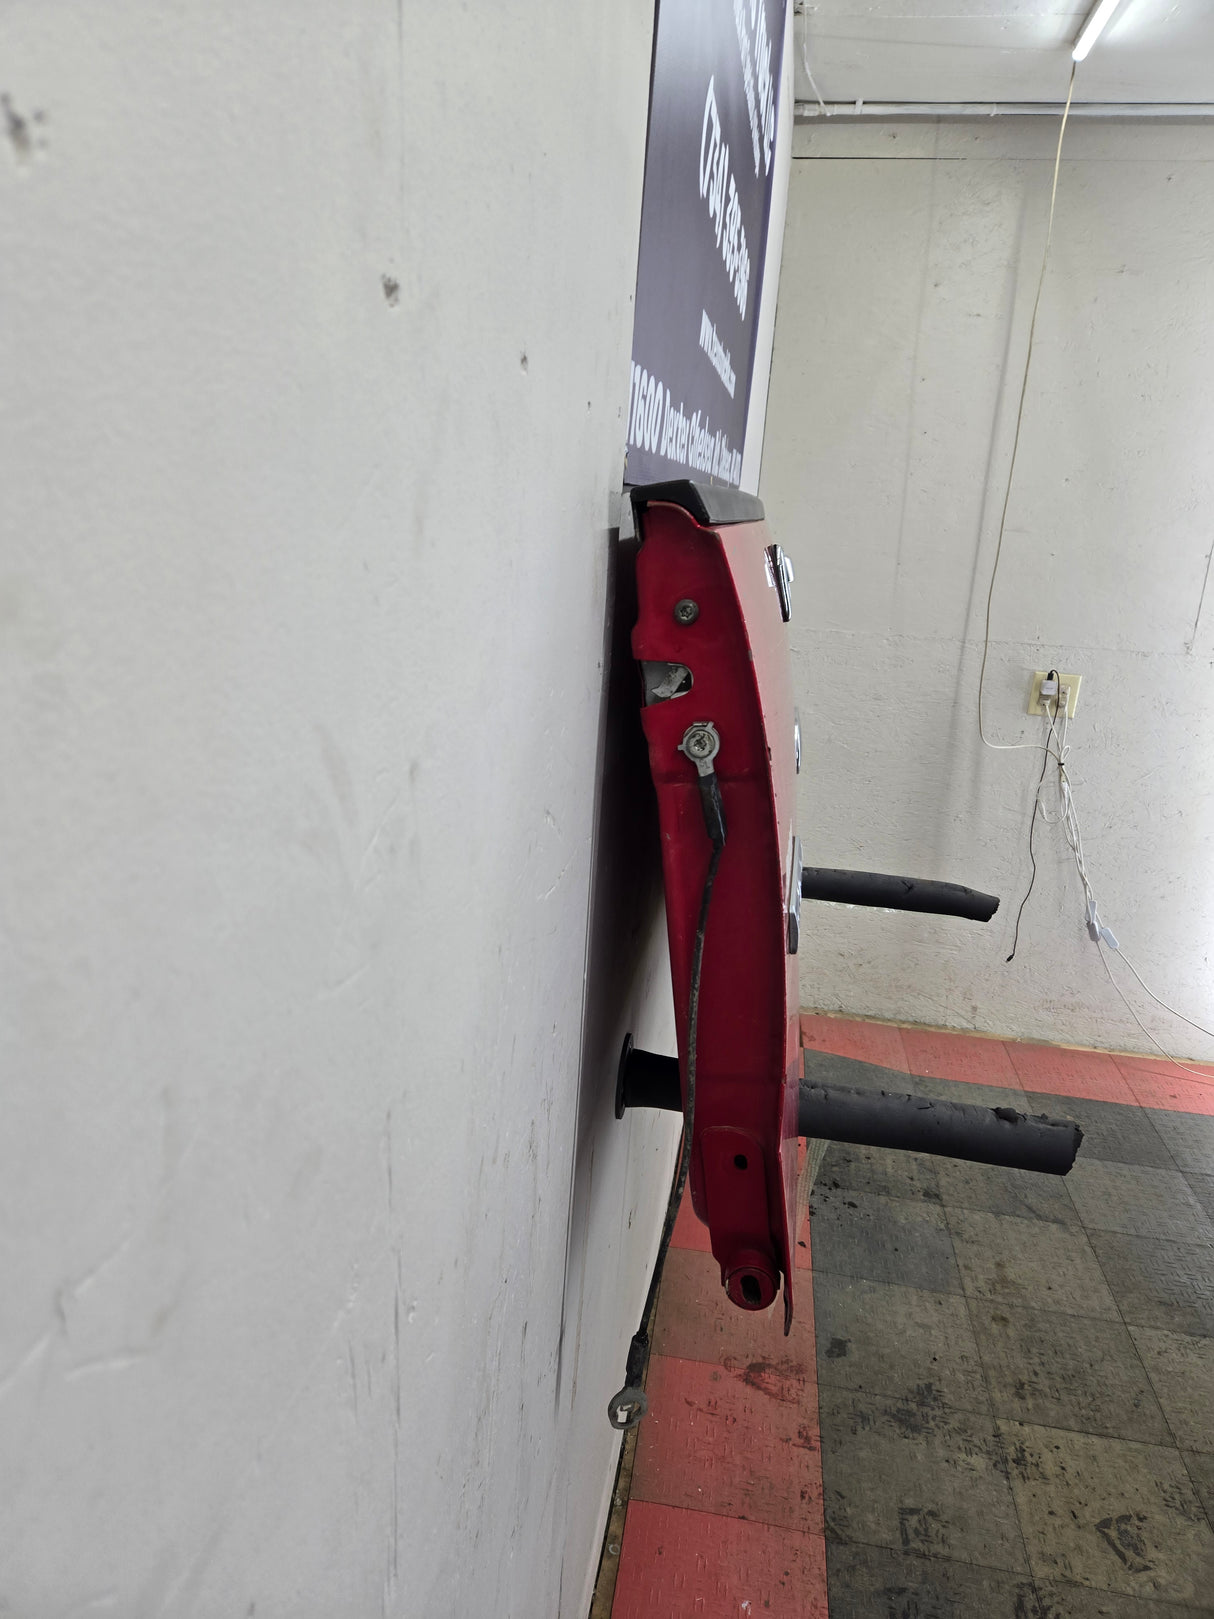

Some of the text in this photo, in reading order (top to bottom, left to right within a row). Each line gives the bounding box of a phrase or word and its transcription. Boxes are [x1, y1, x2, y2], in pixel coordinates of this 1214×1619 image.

[700, 74, 728, 248] (734)
[660, 388, 690, 464] Dexter
[688, 409, 715, 474] Chelsea
